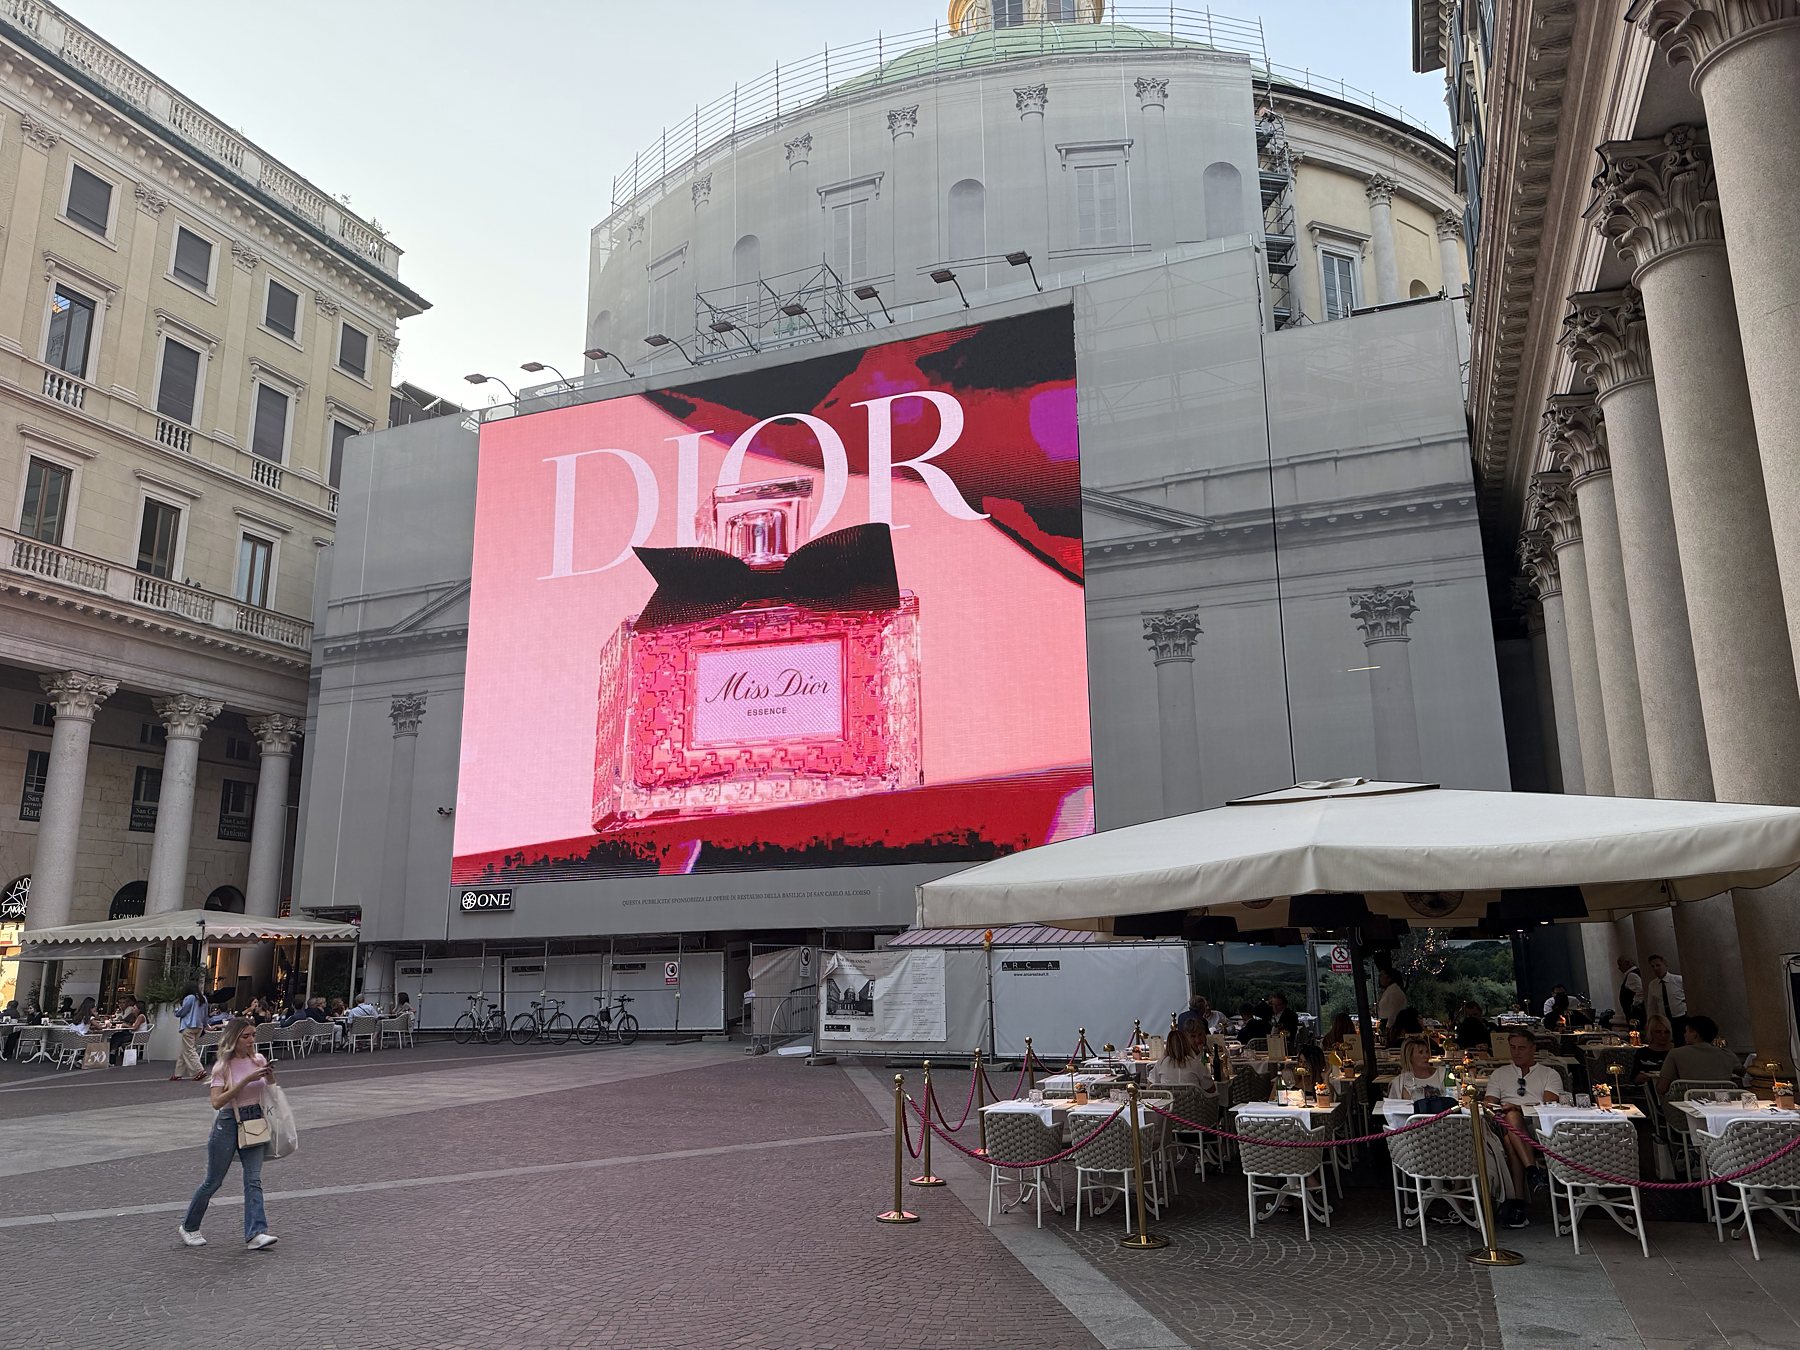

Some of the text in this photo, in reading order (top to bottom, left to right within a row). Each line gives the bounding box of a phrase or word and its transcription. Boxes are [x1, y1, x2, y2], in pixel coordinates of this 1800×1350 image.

[537, 391, 991, 581] DIOR
[705, 668, 830, 703] Miss Dior
[747, 706, 787, 716] ESSENCE
[477, 893, 511, 907] ONE
